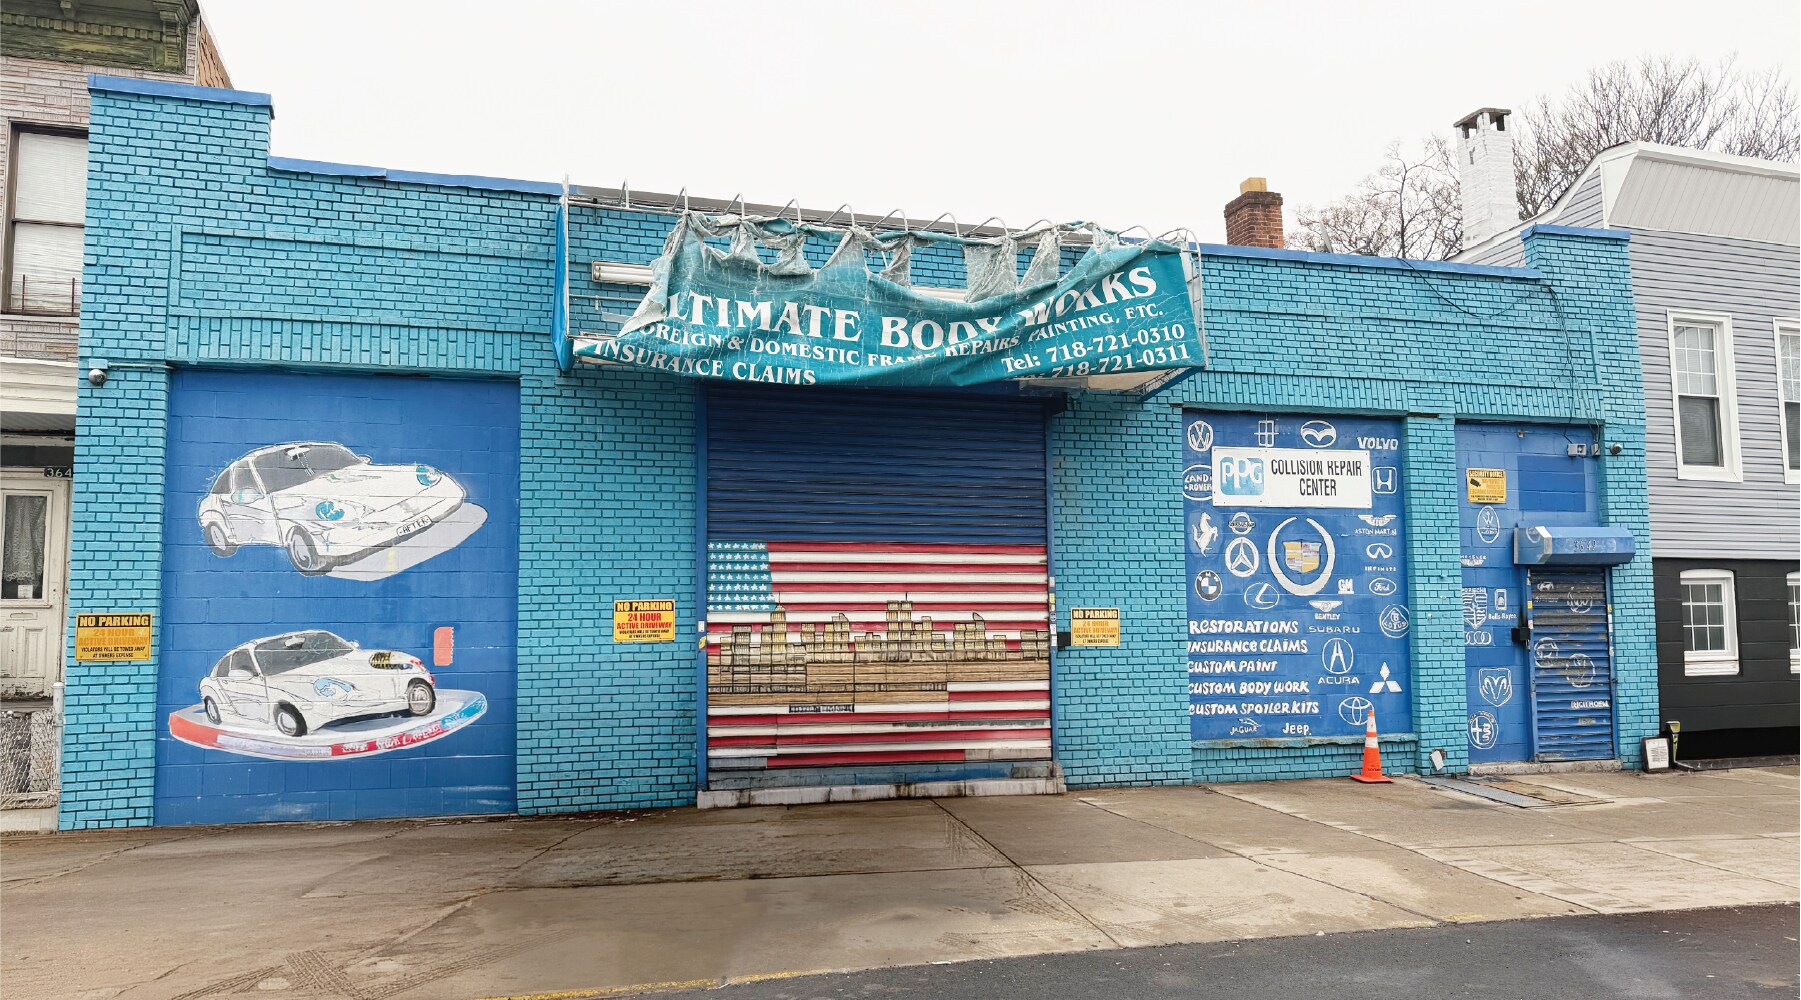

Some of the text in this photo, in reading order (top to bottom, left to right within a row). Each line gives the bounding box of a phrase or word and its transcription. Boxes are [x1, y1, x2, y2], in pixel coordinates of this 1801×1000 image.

[667, 289, 862, 342] LTIMATE
[880, 316, 1002, 351] BODY
[639, 322, 722, 348] OREIGN
[727, 335, 744, 350] &
[750, 337, 860, 366] DOMESTIC
[1124, 303, 1164, 320] ETC.
[1001, 323, 1186, 373] Tel: 718-721-0310
[593, 338, 816, 386] INSURANCE CLAIMS
[1052, 342, 1191, 379] 718-721-0311
[1357, 436, 1399, 451] VOLVO
[46, 467, 72, 478] 364
[1221, 456, 1362, 489] PPG COLLISION REPAIR
[1299, 478, 1337, 497] CENTER
[616, 601, 673, 611] NO PARKING
[628, 612, 662, 621] 24 HOUR
[1073, 609, 1118, 619] NO PARKING
[79, 615, 149, 627] NO PARKING
[616, 621, 673, 630] ACTIVE DRIVEWAY
[93, 628, 135, 637] 24 HOUR
[1308, 625, 1361, 634] SUBARU
[78, 636, 149, 646] ACTIVE DRIVEWAY
[1188, 660, 1237, 674] CUSTOM
[1317, 676, 1360, 685] ACURA
[1188, 681, 1310, 695] CUSTOM BODY WORK
[1189, 703, 1239, 715] CUSTOM
